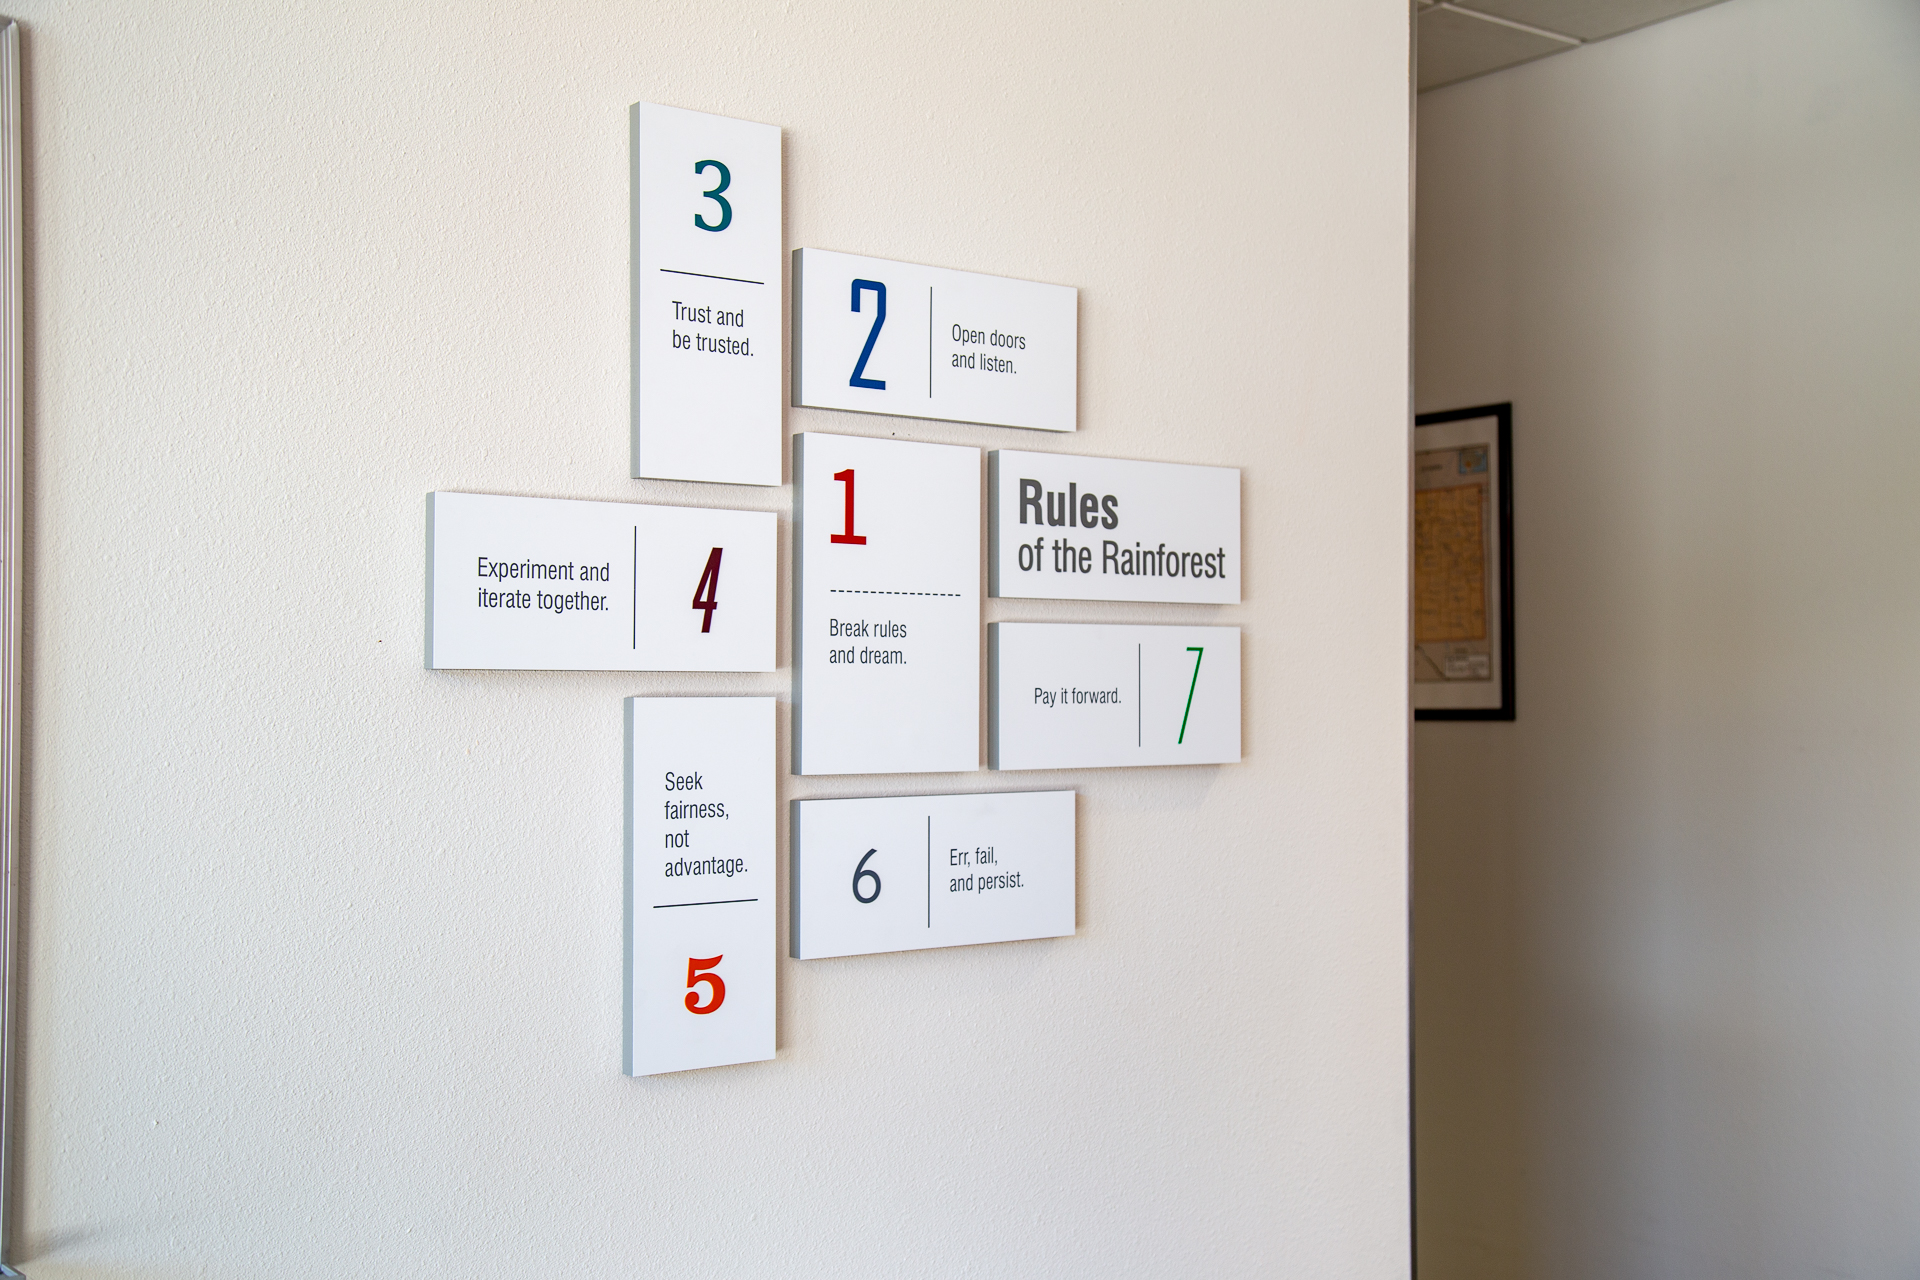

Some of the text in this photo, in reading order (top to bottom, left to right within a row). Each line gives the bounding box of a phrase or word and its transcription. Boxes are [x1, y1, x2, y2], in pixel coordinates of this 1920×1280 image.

[694, 159, 733, 233] 3
[671, 300, 744, 328] Trust and
[672, 328, 754, 357] be trusted.
[848, 278, 887, 391] 2
[951, 323, 1026, 350] Open doors
[951, 352, 1017, 375] and listen.
[830, 468, 867, 546] 1
[1019, 477, 1119, 531] Rules
[477, 556, 610, 583] Experiment and
[1018, 536, 1226, 579] of the Rainforest
[478, 586, 609, 615] iterate together.
[691, 546, 724, 634] 4
[829, 618, 907, 639] Break rules
[829, 645, 907, 665] and dream.
[1034, 687, 1122, 709] Pay it forward.
[1177, 646, 1205, 745] 7
[664, 771, 704, 792] Seek
[663, 800, 729, 821] fairness,
[665, 829, 690, 849] not
[664, 856, 748, 878] advantage.
[950, 846, 998, 868] Err, fail,
[852, 847, 882, 905] 6
[949, 871, 1024, 895] and persist.
[683, 953, 727, 1016] 5
